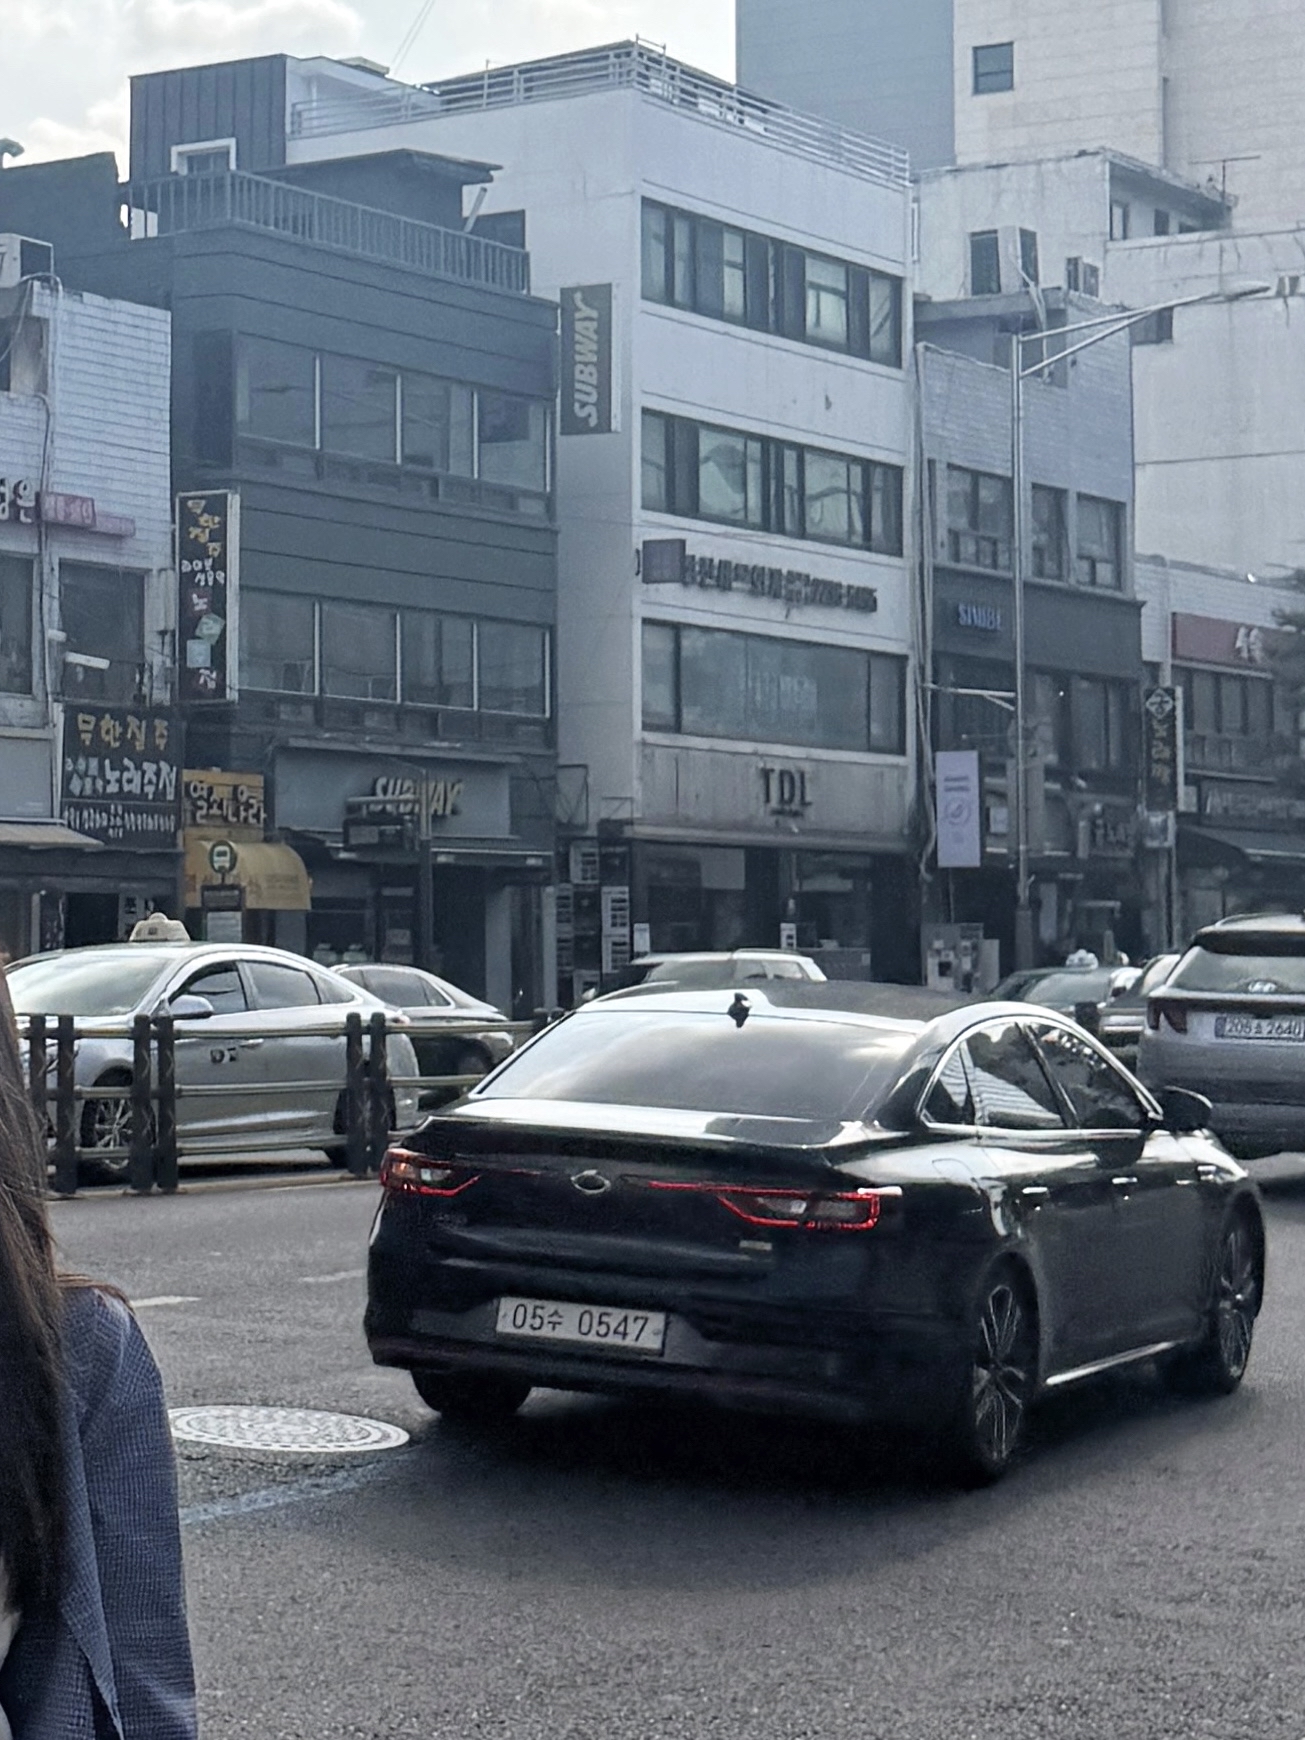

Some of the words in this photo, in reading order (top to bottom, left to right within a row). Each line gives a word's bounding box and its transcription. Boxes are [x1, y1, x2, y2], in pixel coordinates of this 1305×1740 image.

[573, 290, 599, 428] SUBWAY
[77, 712, 168, 751] 무한질주
[104, 757, 176, 800] 노래주점
[512, 1303, 564, 1331] 05수
[578, 1309, 649, 1342] 0547
